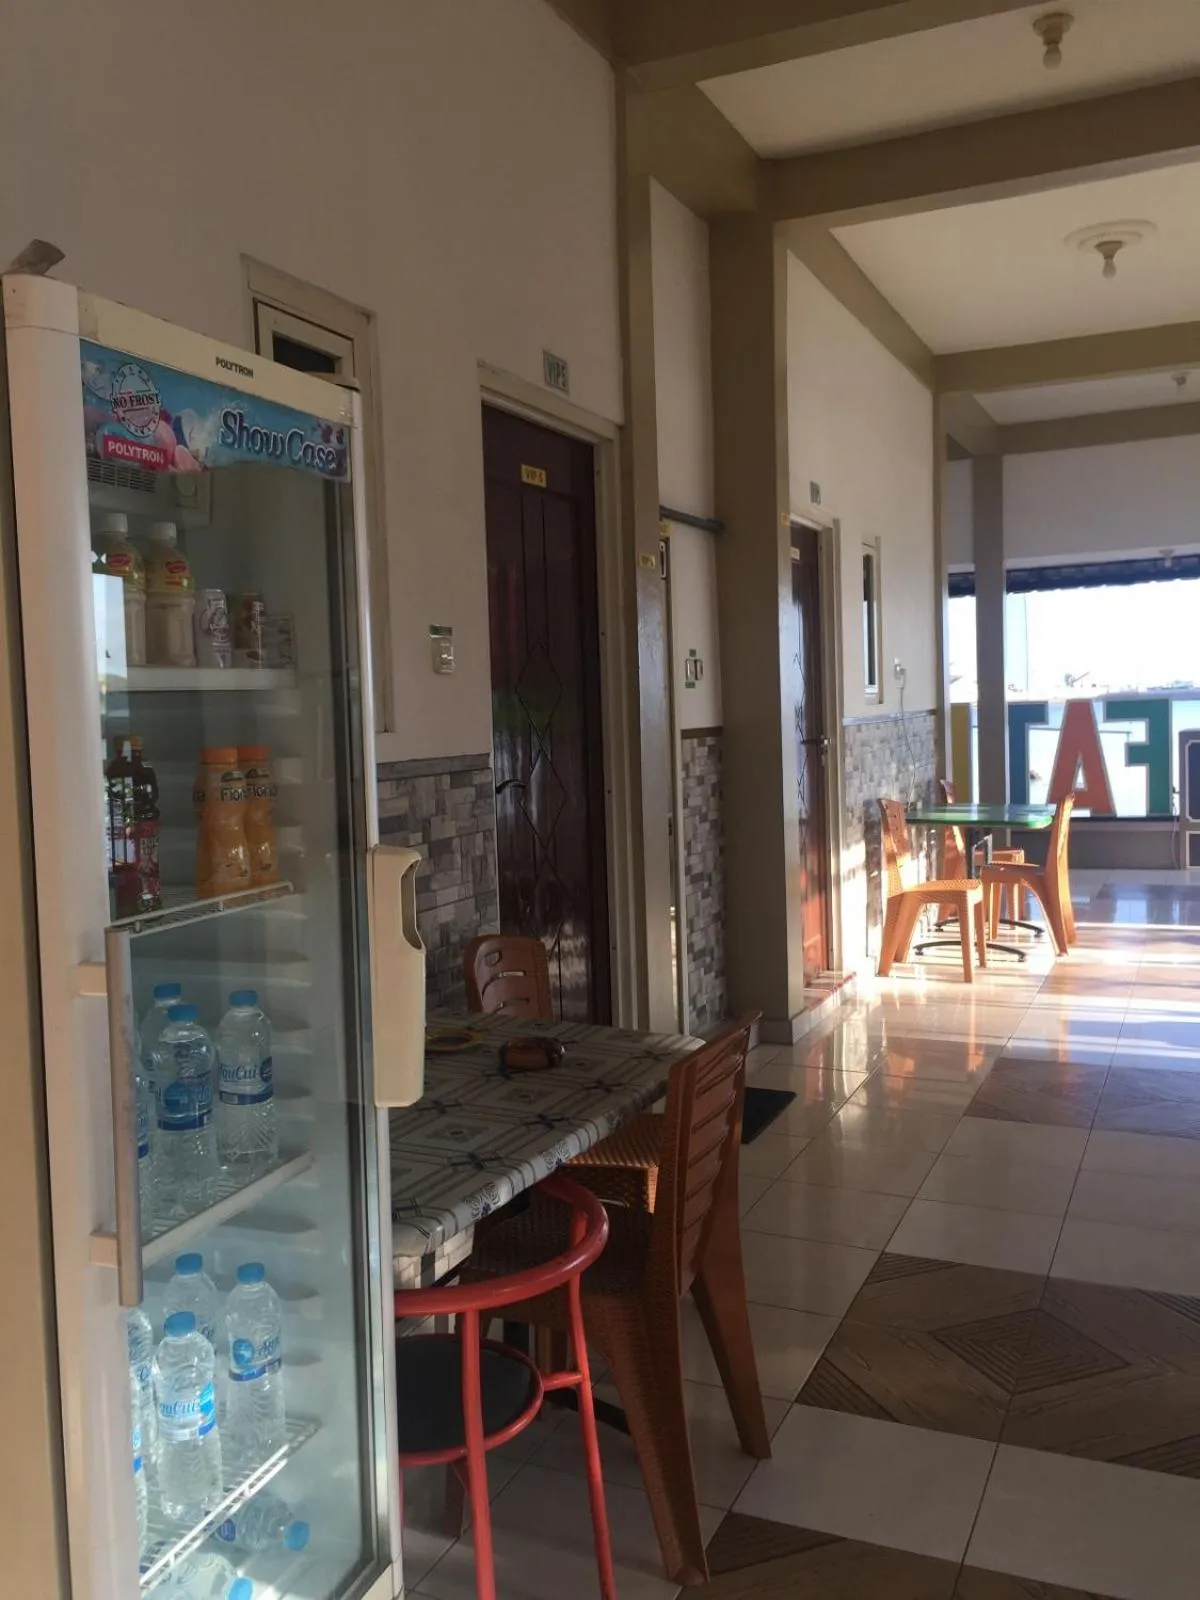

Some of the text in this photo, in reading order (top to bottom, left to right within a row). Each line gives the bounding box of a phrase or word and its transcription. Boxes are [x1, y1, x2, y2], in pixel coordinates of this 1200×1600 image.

[215, 356, 254, 379] POLYTRON
[112, 392, 160, 410] NO FROST
[107, 440, 164, 464] POLYTRON
